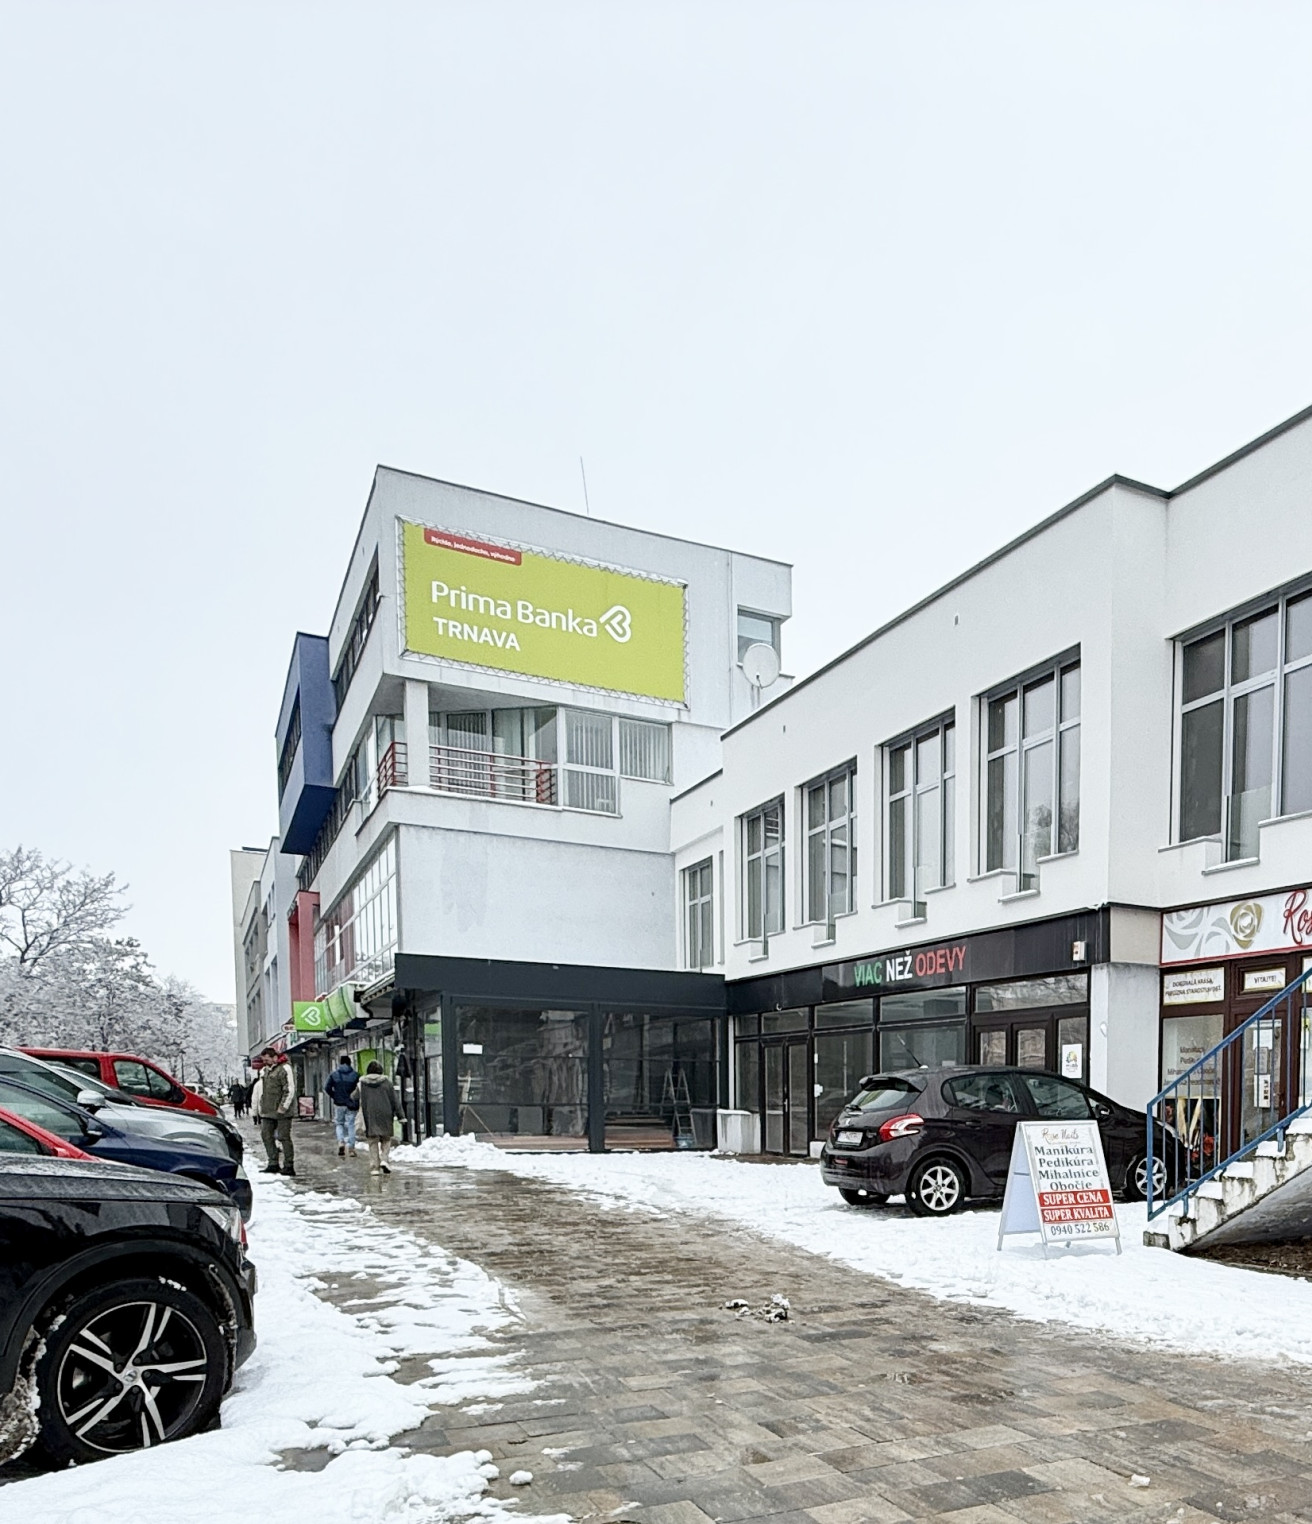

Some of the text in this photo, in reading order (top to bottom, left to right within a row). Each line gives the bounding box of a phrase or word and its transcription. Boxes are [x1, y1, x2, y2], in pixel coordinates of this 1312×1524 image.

[431, 580, 598, 638] Prima Banka
[432, 616, 521, 651] TRNAVA
[854, 945, 967, 987] VIAC NEŽ ODEVY
[1034, 1145, 1094, 1156] Manikúra
[1039, 1157, 1094, 1168] Pedikúra
[1039, 1169, 1099, 1181] Mihalnice
[1050, 1181, 1093, 1192] Obočie
[1043, 1191, 1104, 1205] SUPER CENA
[1043, 1206, 1110, 1222] SUPER KVALITA
[1050, 1225, 1073, 1236] 0940
[1075, 1223, 1091, 1234] 522
